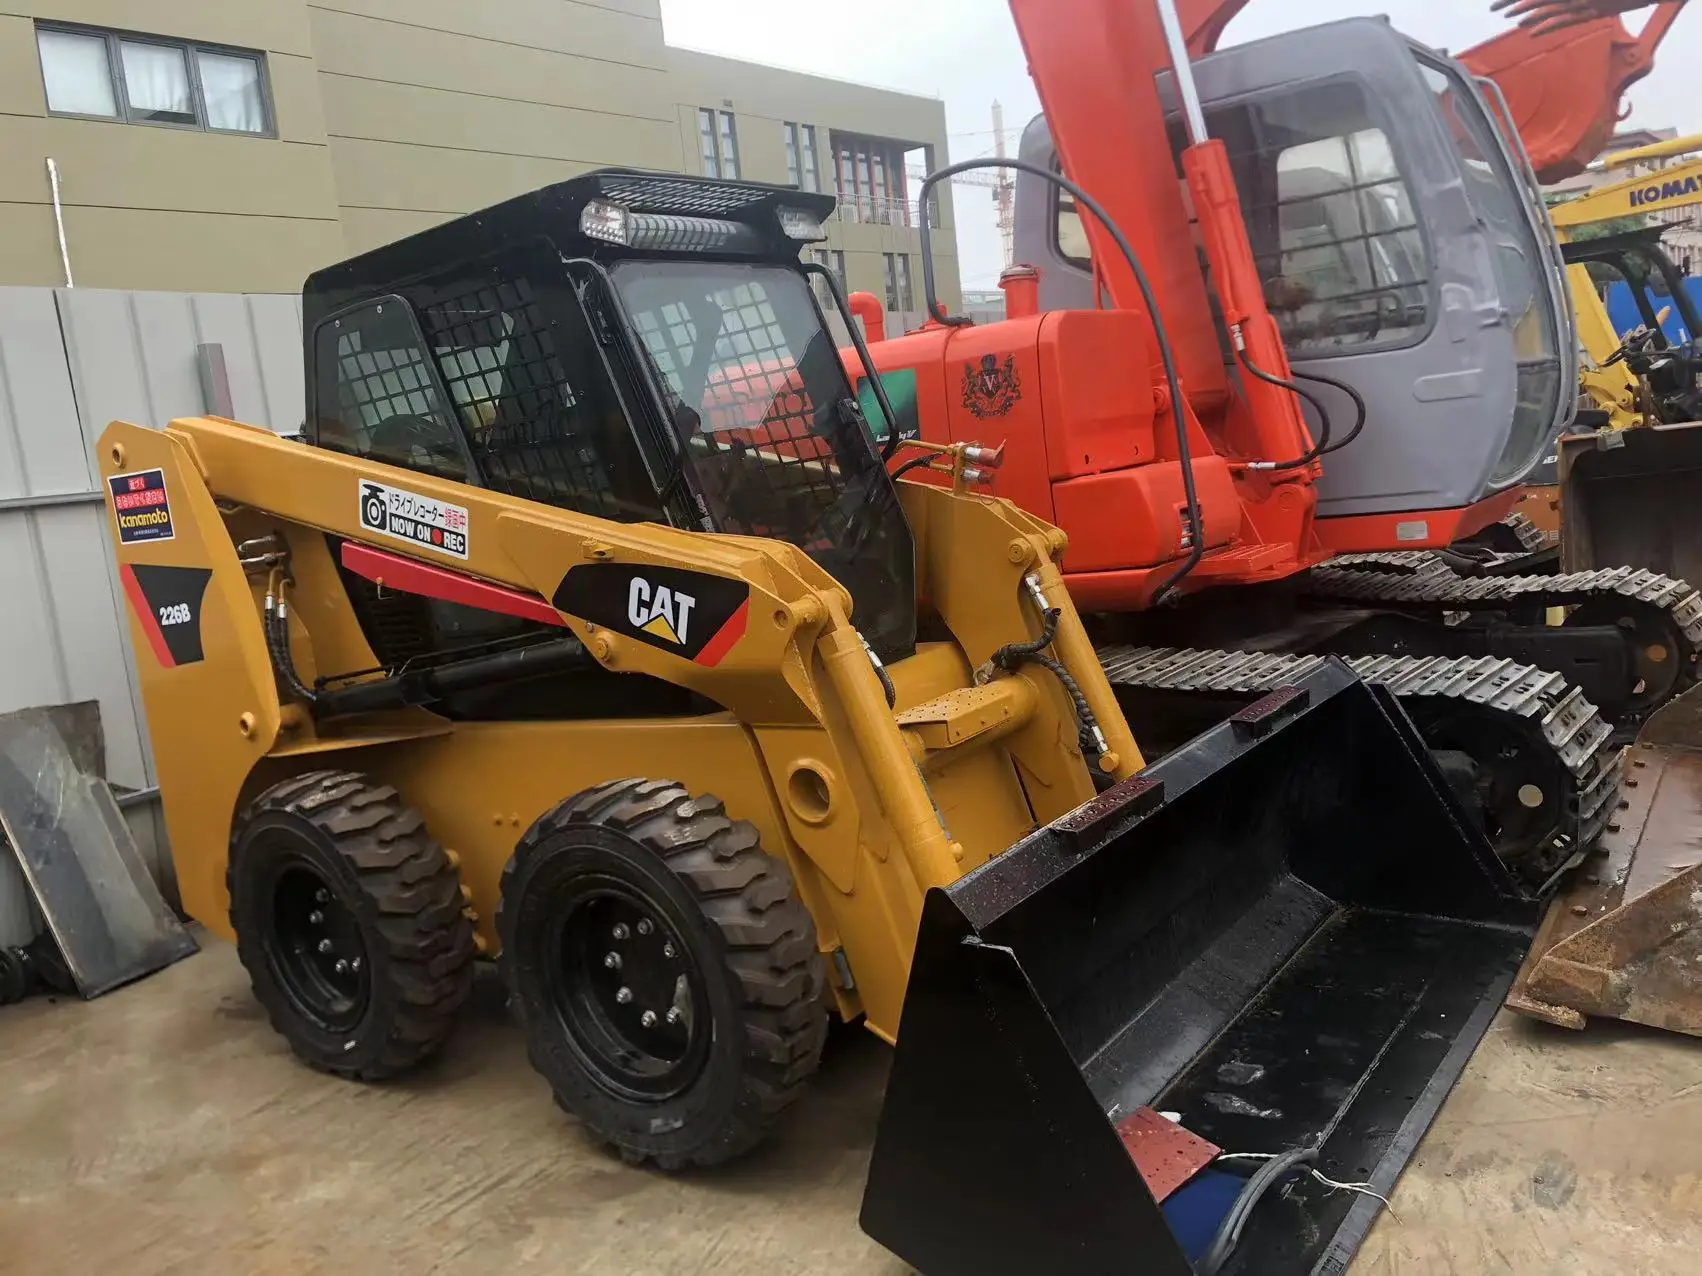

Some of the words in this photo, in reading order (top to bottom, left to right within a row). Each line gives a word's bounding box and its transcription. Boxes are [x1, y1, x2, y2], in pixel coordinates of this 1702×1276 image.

[119, 508, 168, 528] kanamoto
[391, 516, 415, 537] NOW
[416, 523, 431, 543] ON
[443, 532, 464, 552] REC
[159, 602, 192, 626] 226B
[628, 576, 696, 645] CAT
